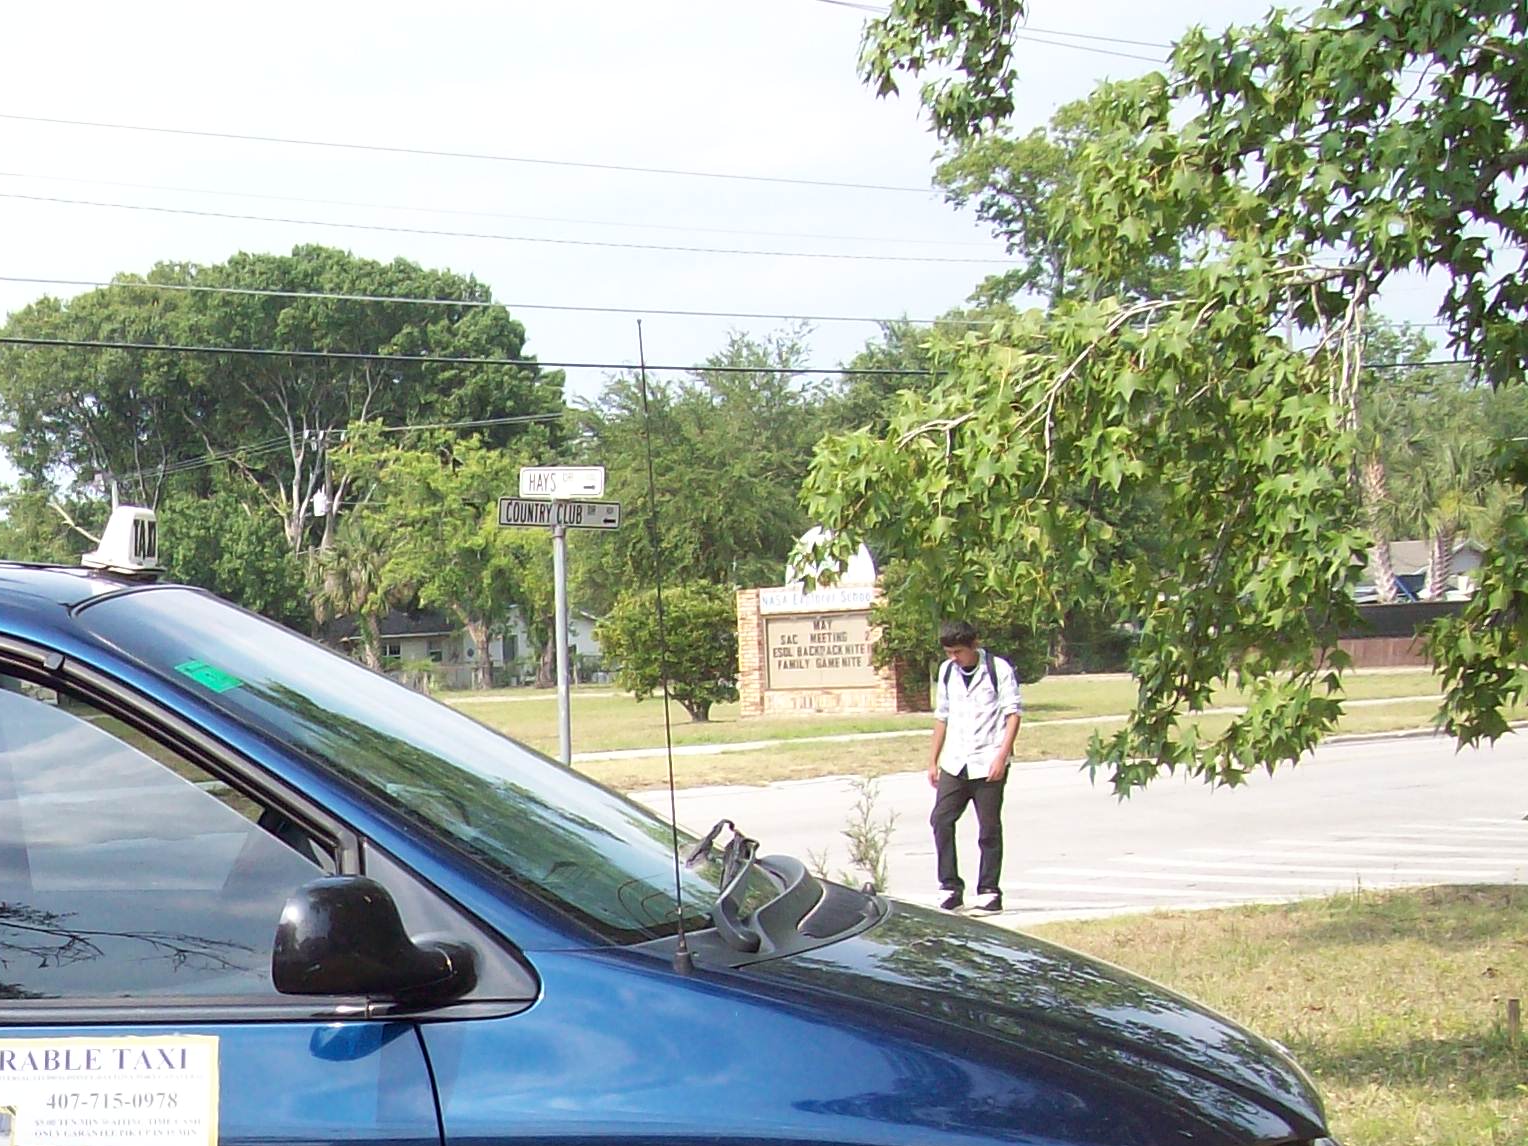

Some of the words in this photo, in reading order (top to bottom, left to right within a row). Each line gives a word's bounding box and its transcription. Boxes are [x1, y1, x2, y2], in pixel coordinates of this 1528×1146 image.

[528, 472, 557, 492] HAYS
[506, 501, 553, 523] COUNTRY
[557, 504, 583, 525] CLUB
[761, 594, 788, 608] NASA
[840, 590, 871, 604] Schoo
[812, 619, 833, 631] MAY
[779, 634, 799, 645] SAC
[809, 631, 848, 643] MEETING
[844, 644, 865, 655] NITE
[777, 659, 810, 670] FAMILY
[815, 658, 841, 669] GAME
[841, 656, 863, 668] NITE
[110, 1047, 188, 1071] TAXI
[46, 1091, 179, 1110] 407-715-0978
